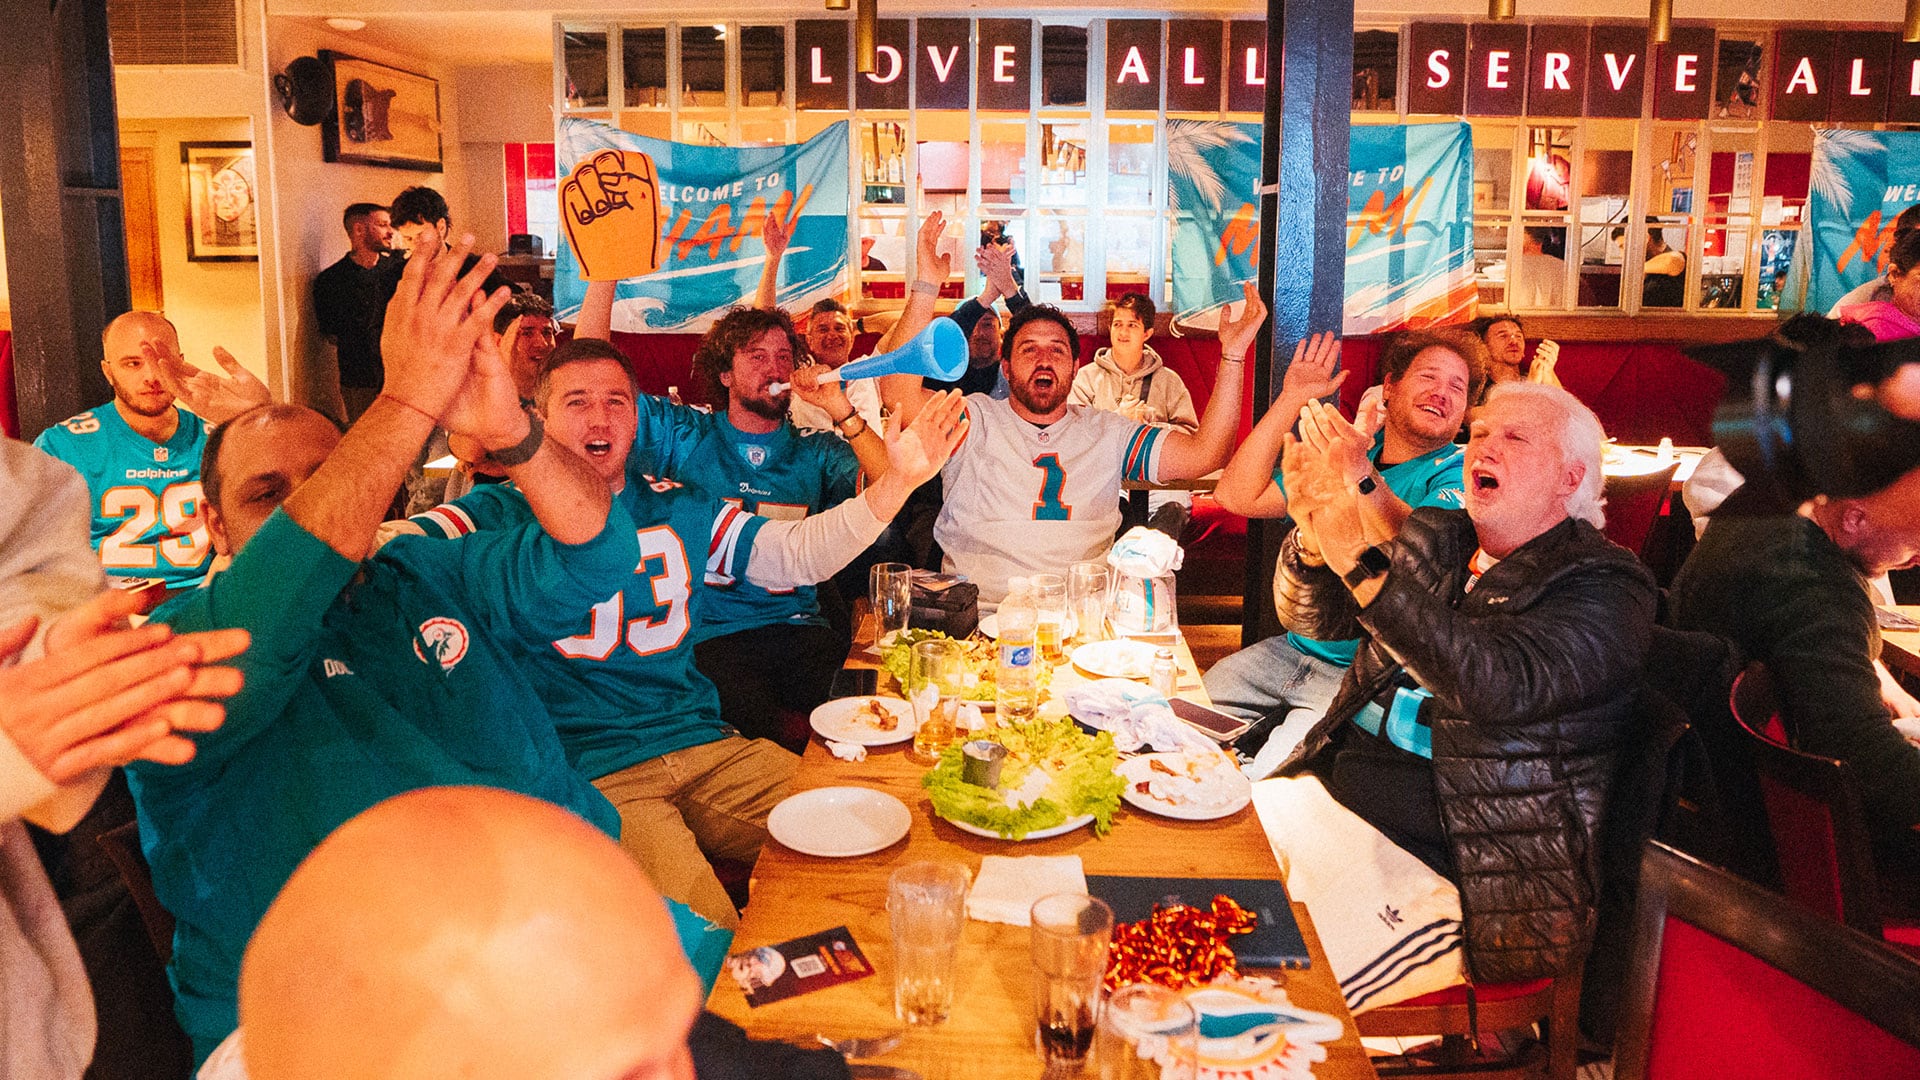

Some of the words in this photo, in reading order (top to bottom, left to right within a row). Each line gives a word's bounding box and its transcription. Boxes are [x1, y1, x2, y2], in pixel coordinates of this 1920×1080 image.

[811, 45, 1016, 84] LOVE
[1116, 46, 1266, 85] ALL
[1426, 50, 1698, 92] SERVE
[660, 181, 744, 204] ELCOME
[756, 173, 780, 191] TO
[1378, 165, 1404, 185] TO
[1883, 184, 1920, 202] WE
[660, 183, 814, 264] IAMI
[126, 468, 189, 480] Dolphins
[1032, 452, 1072, 521] 1
[100, 481, 213, 568] 29
